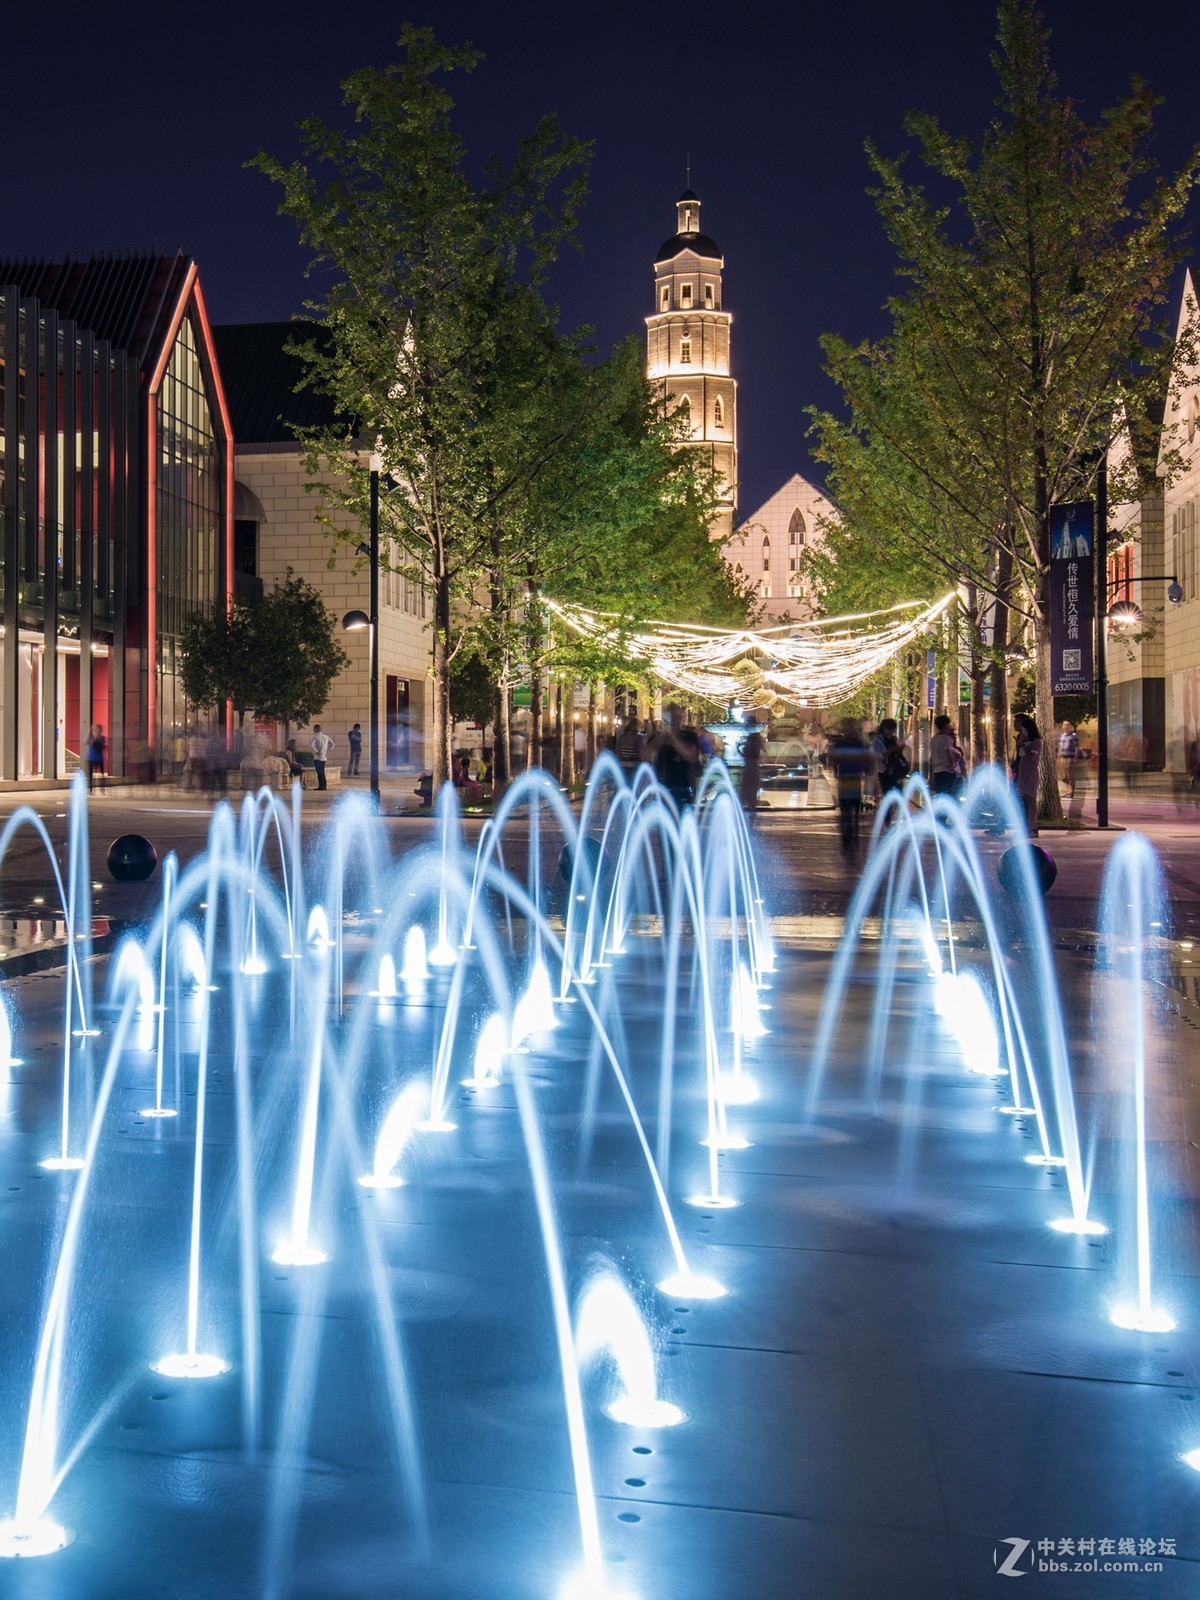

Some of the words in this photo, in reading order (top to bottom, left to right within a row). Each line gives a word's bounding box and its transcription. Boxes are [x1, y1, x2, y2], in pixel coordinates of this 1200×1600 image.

[1066, 562, 1079, 640] 传世恒久爱情
[1054, 683, 1072, 692] 6320
[1073, 682, 1090, 691] 0005
